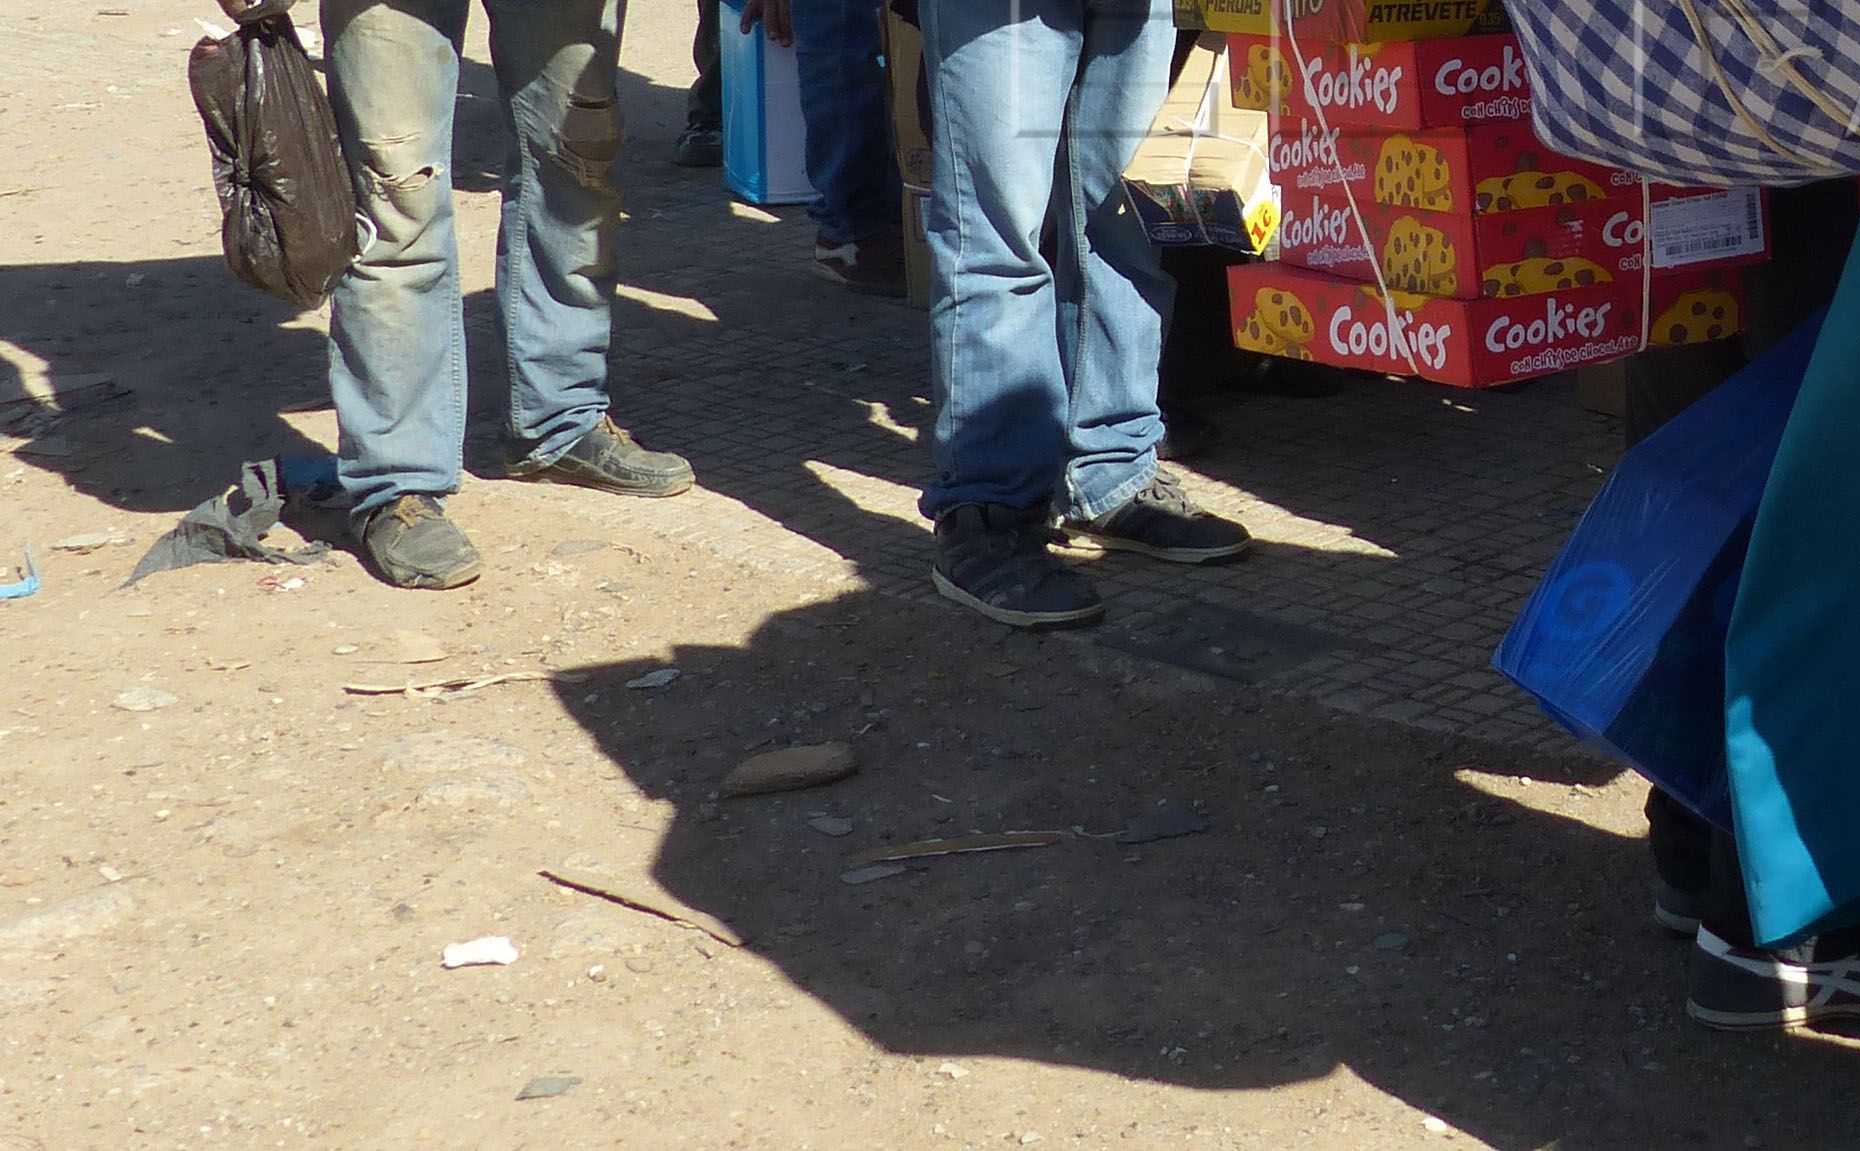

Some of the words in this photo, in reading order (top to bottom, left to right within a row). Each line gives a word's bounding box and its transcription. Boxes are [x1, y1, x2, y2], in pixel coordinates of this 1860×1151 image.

[1303, 44, 1403, 115] Cookies
[1434, 45, 1530, 96] Cook
[1269, 118, 1342, 174] Cookies
[1281, 194, 1354, 250] Cookies
[1329, 297, 1452, 370] Cookies
[1485, 298, 1612, 354] Cookies
